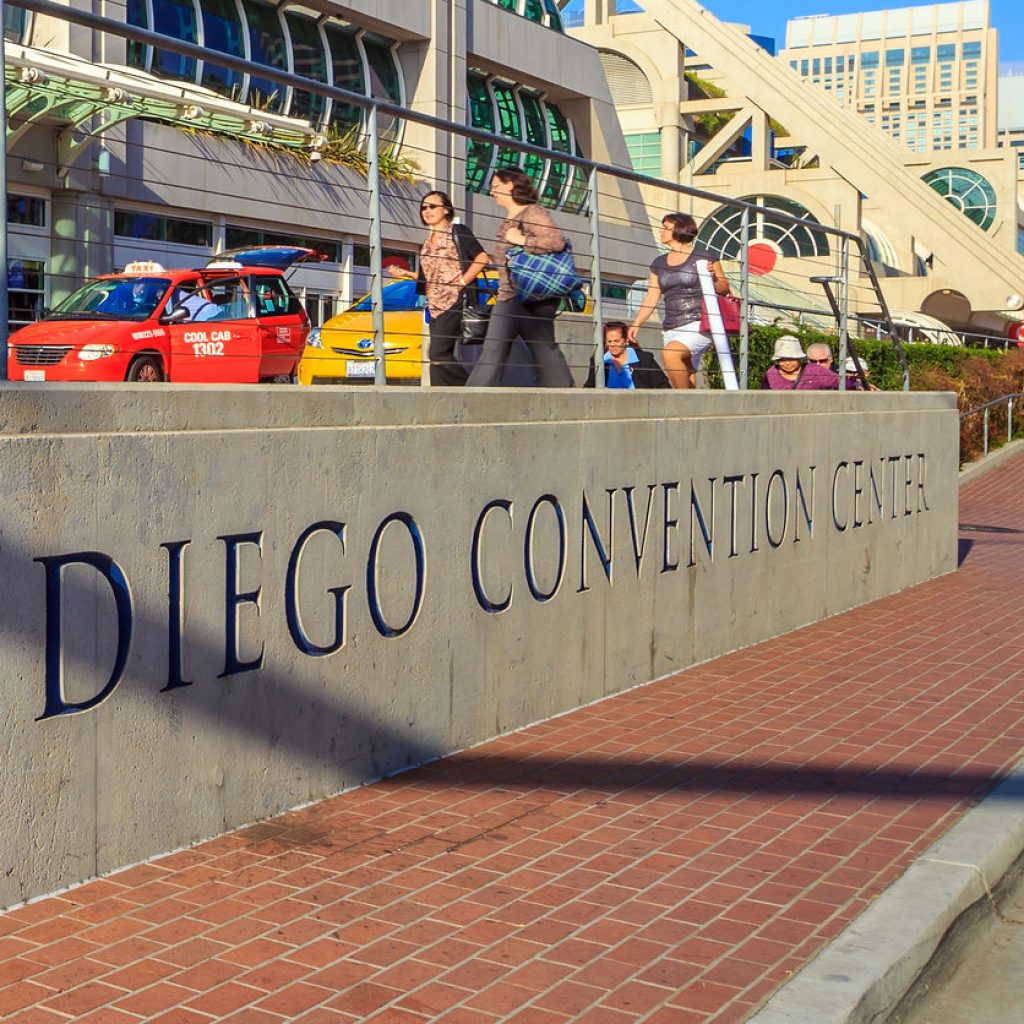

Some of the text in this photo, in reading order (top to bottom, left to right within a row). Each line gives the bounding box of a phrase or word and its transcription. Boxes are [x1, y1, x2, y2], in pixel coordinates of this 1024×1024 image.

[184, 330, 231, 343] COOL CAB
[192, 341, 225, 357] 1302
[33, 510, 428, 723] DIEGO
[471, 465, 818, 616] CONVENTION
[831, 452, 931, 534] CENTER
